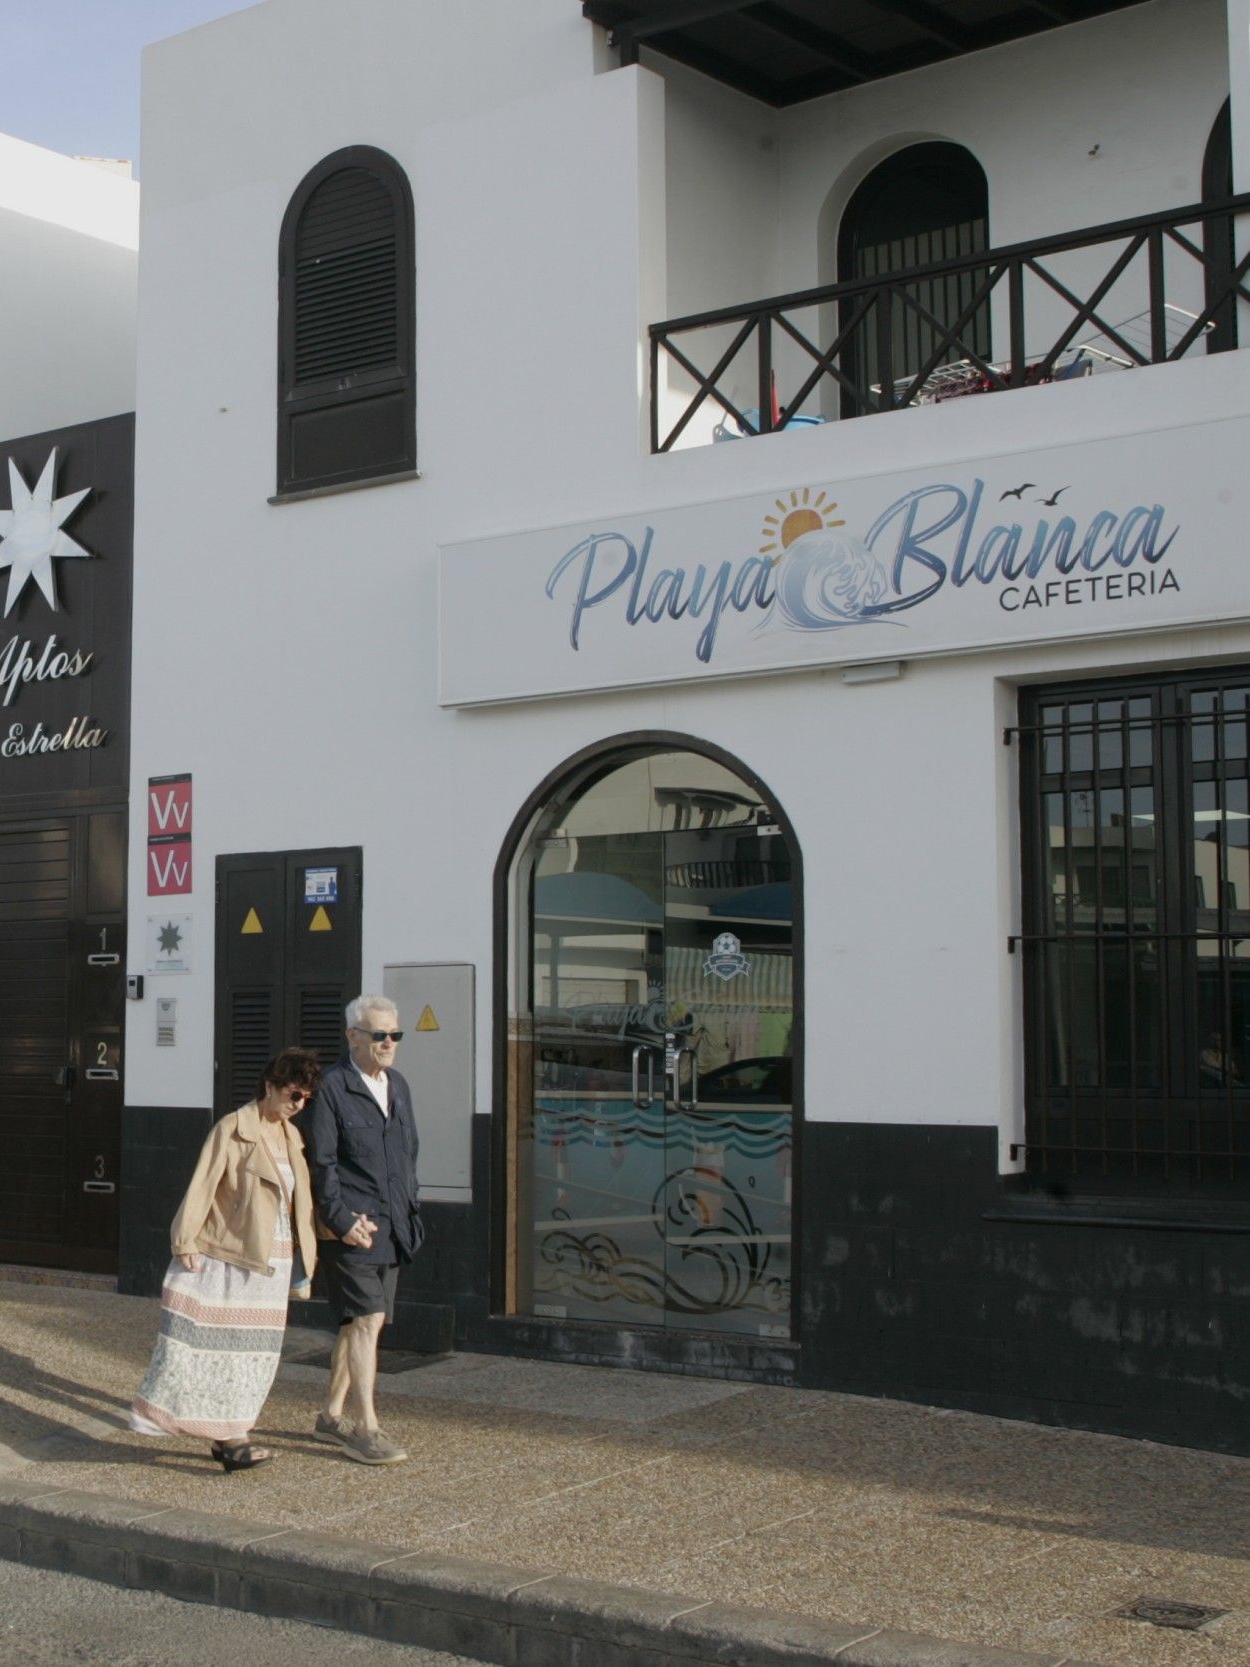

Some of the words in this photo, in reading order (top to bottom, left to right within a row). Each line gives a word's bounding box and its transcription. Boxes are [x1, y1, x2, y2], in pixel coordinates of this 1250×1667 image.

[546, 526, 777, 663] Playa
[860, 479, 1180, 618] Blanca
[998, 568, 1180, 612] CAFETERIA
[1, 716, 108, 758] Estrella
[99, 927, 107, 951] 1
[97, 1041, 107, 1065] 2
[94, 1155, 105, 1179] 3
